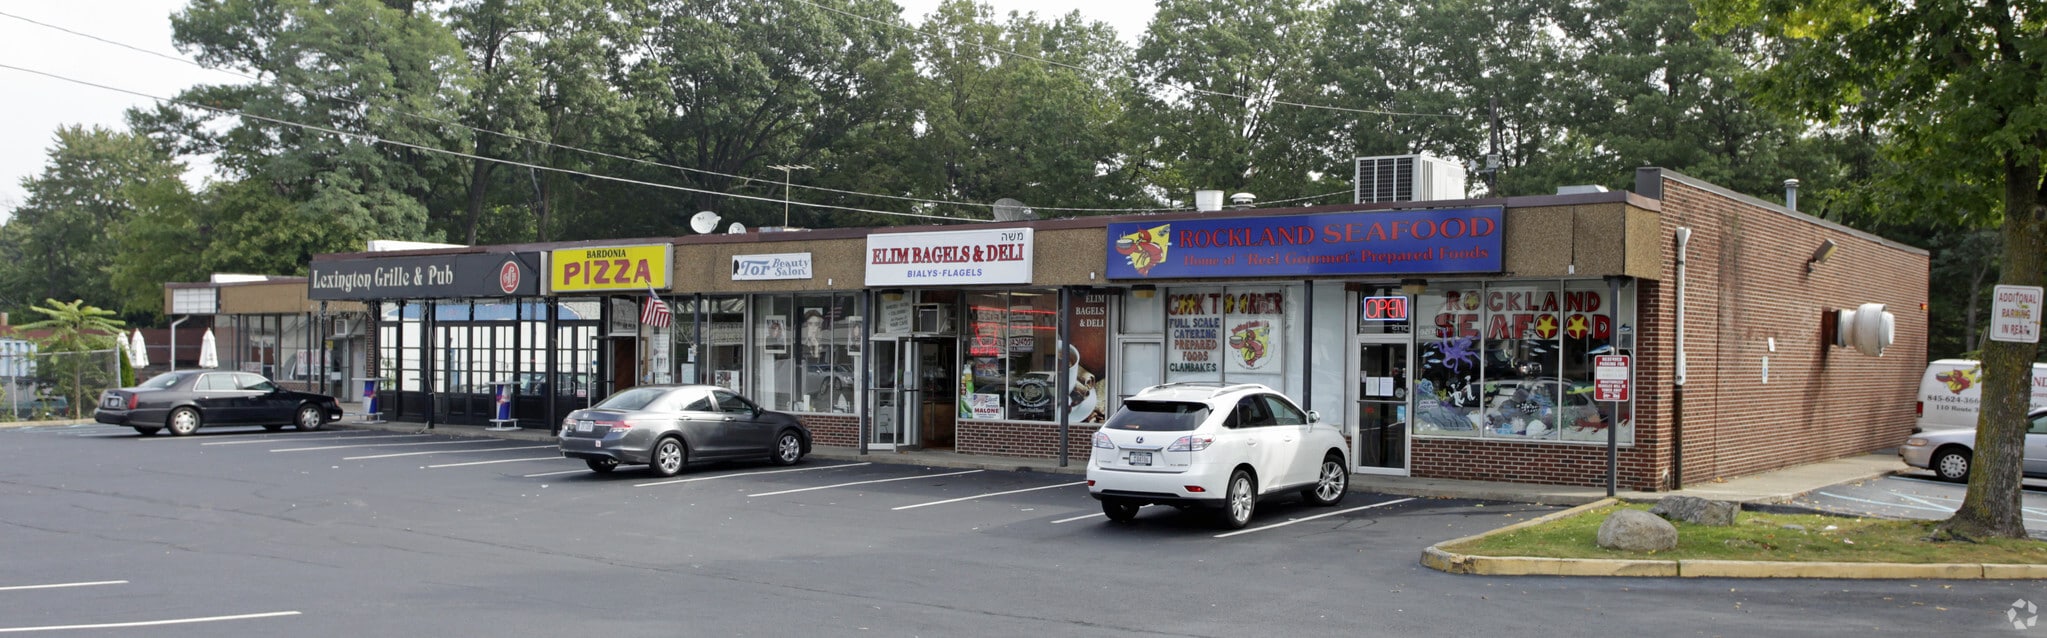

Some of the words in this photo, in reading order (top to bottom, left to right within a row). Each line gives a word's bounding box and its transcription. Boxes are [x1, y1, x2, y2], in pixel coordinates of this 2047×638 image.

[1001, 232, 1024, 242] משה
[1179, 225, 1316, 248] ROCKLAND
[1322, 216, 1496, 244] SEAFOOD
[586, 249, 627, 259] BARDONIA
[872, 248, 909, 265] ELIM
[911, 246, 970, 264] BAGELS
[973, 245, 985, 262] &
[986, 243, 1025, 261] DELI
[1184, 253, 1219, 266] Home
[1360, 247, 1433, 264] Prepared
[1439, 245, 1489, 259] Foods
[741, 260, 770, 275] Tor
[772, 258, 809, 268] Beauty
[774, 267, 807, 276] Salon
[563, 259, 652, 285] PIZZA
[313, 270, 372, 293] Lexington
[374, 266, 410, 287] Grille
[414, 266, 423, 286] &
[428, 264, 453, 285] Pub
[1085, 294, 1105, 303] ELIM
[1446, 290, 1600, 312] ROCKLAND
[1167, 293, 1206, 315] COOK
[1366, 298, 1406, 318] OPEN
[1075, 306, 1105, 315] BAGELS
[1079, 318, 1085, 327] &
[1086, 319, 1104, 327] DELI
[1168, 318, 1191, 328] FULL
[1193, 318, 1220, 328] SCALE
[1435, 312, 1611, 340] SEAFOOD
[1173, 329, 1217, 339] CATERING
[1174, 340, 1218, 350] PREPARED
[1182, 351, 1209, 361] FOODS
[1169, 363, 1217, 372] CLAMBAKES
